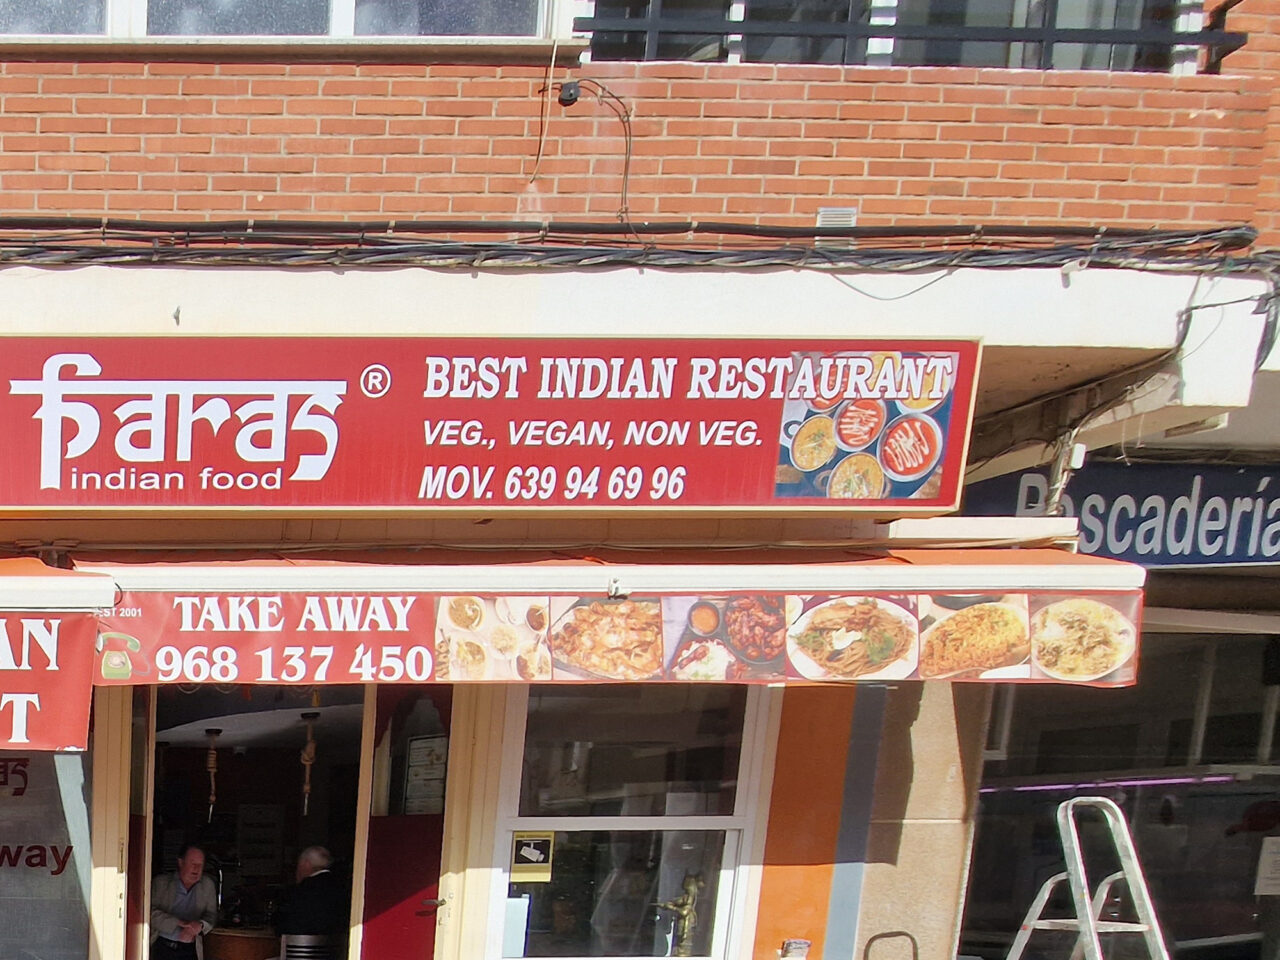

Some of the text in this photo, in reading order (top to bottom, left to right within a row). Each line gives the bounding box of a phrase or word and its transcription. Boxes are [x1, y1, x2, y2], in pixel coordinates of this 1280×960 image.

[424, 356, 953, 400] BEST INDIAN RESTAURANT
[423, 420, 763, 450] VEG., VEGAN, NON VEG.
[71, 467, 282, 490] indian food
[419, 466, 686, 500] MOV. 639 94 69 96
[1016, 473, 1280, 557] Pscadería
[119, 607, 142, 617] 2001
[173, 595, 418, 632] TAKE AWAY
[155, 643, 433, 682] 968 137 450
